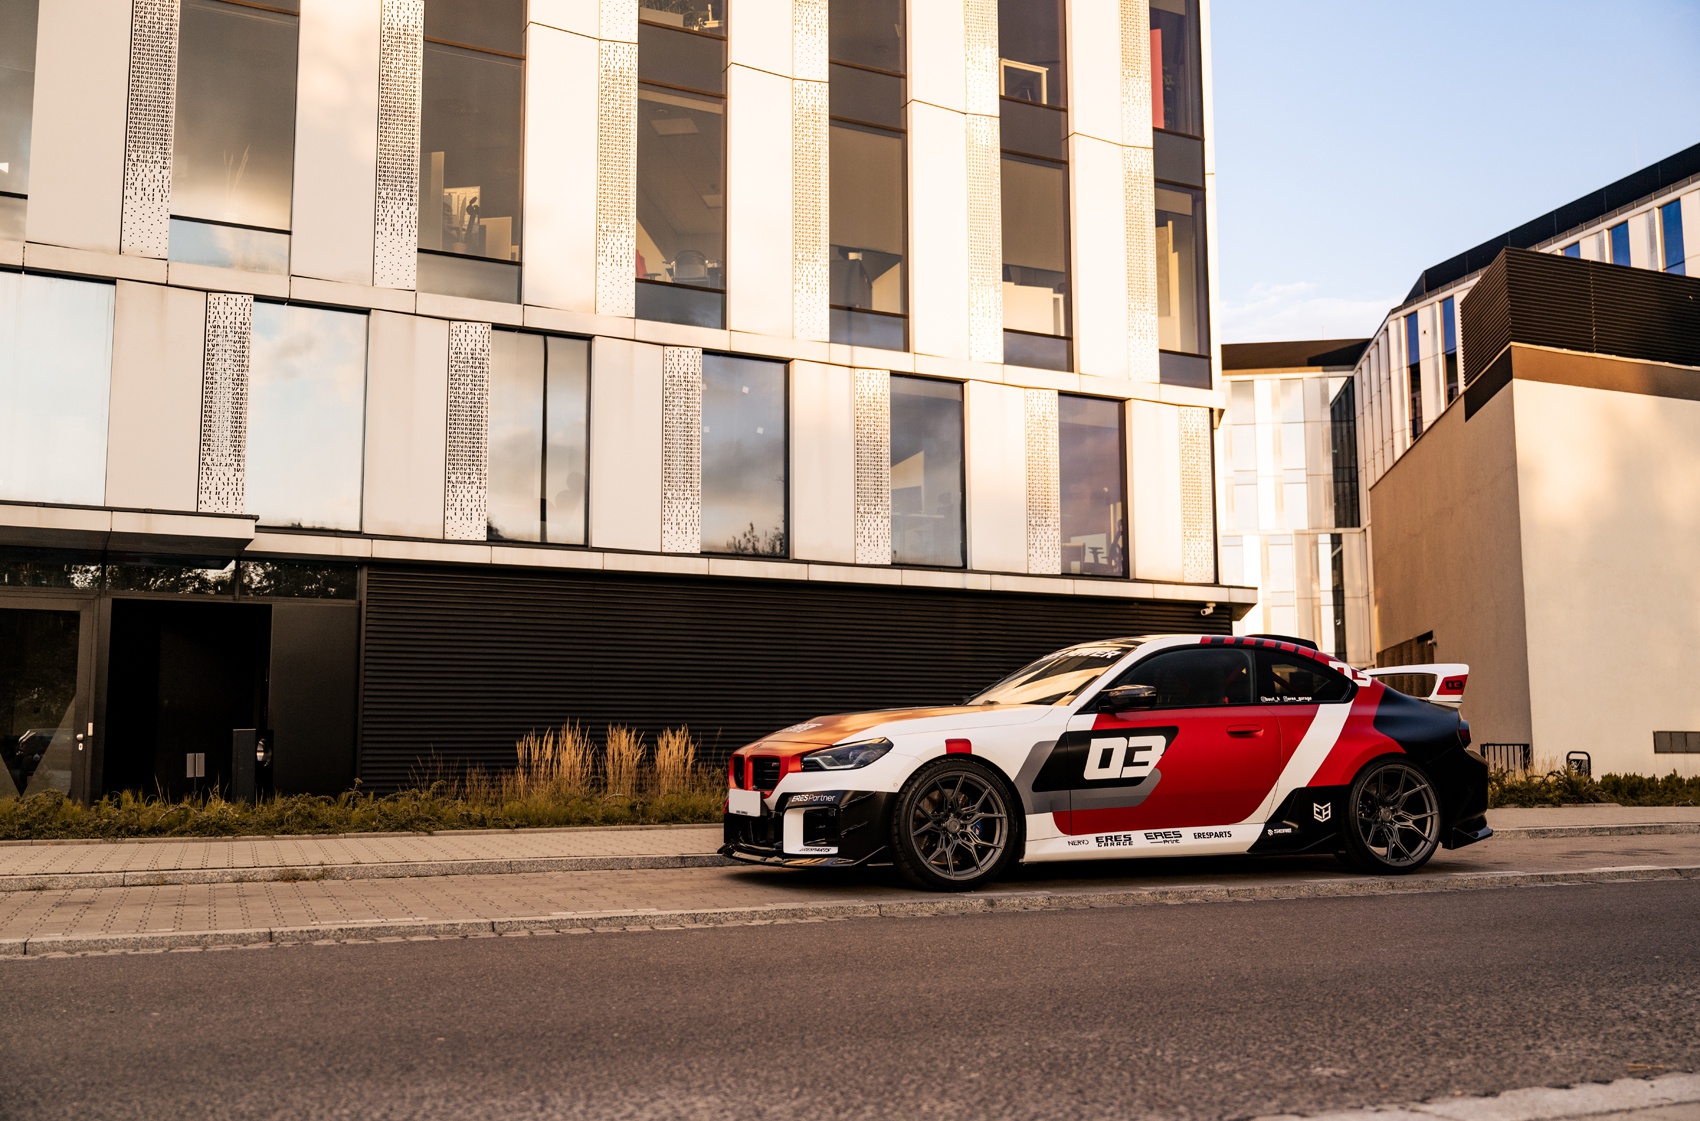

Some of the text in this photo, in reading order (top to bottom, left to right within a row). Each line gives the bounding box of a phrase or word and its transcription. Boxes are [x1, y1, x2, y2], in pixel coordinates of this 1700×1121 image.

[1445, 680, 1463, 690] 03
[1083, 735, 1167, 780] 03
[1095, 834, 1132, 843] ERES
[1144, 830, 1183, 840] ERES
